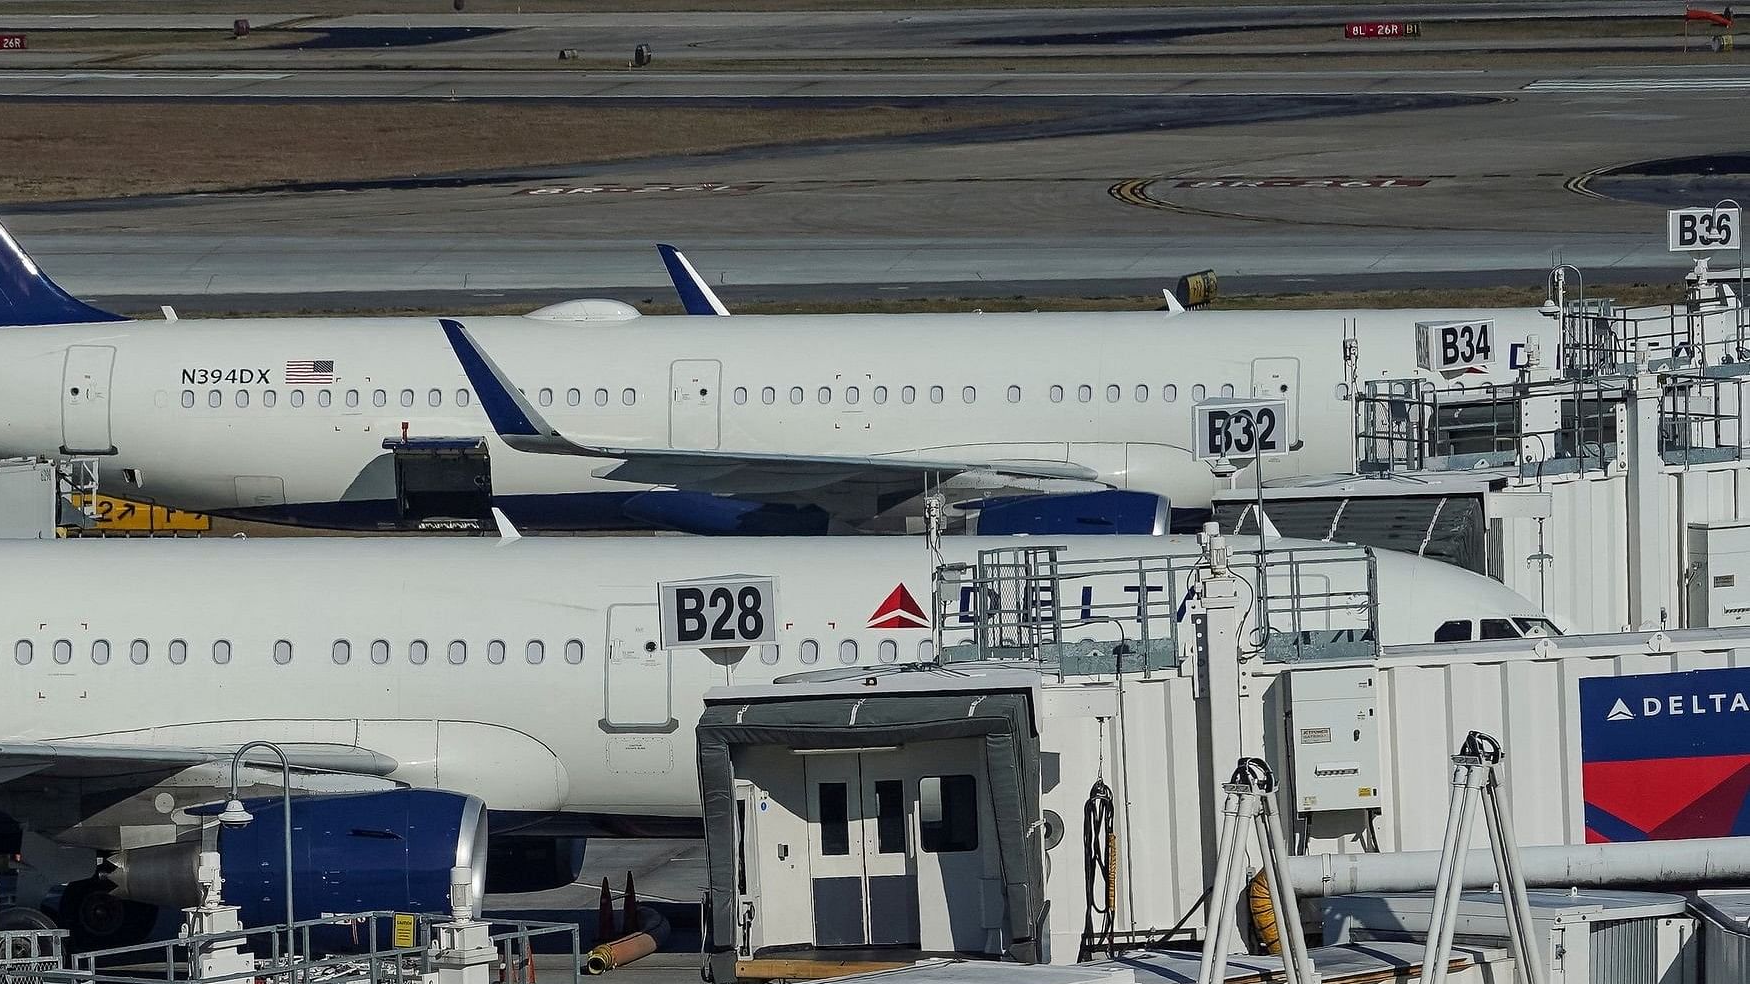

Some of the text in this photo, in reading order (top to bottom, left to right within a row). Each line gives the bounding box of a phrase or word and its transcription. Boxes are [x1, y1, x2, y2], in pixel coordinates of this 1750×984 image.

[3, 38, 21, 48] 26R
[1352, 26, 1365, 36] 8L
[1377, 24, 1398, 35] 26R
[1406, 23, 1417, 34] B1
[1679, 213, 1732, 246] B36
[1442, 324, 1491, 366] B34
[181, 368, 271, 385] N394DX
[1208, 407, 1276, 454] B32
[675, 586, 764, 642] B28
[1643, 692, 1750, 717] DELTA
